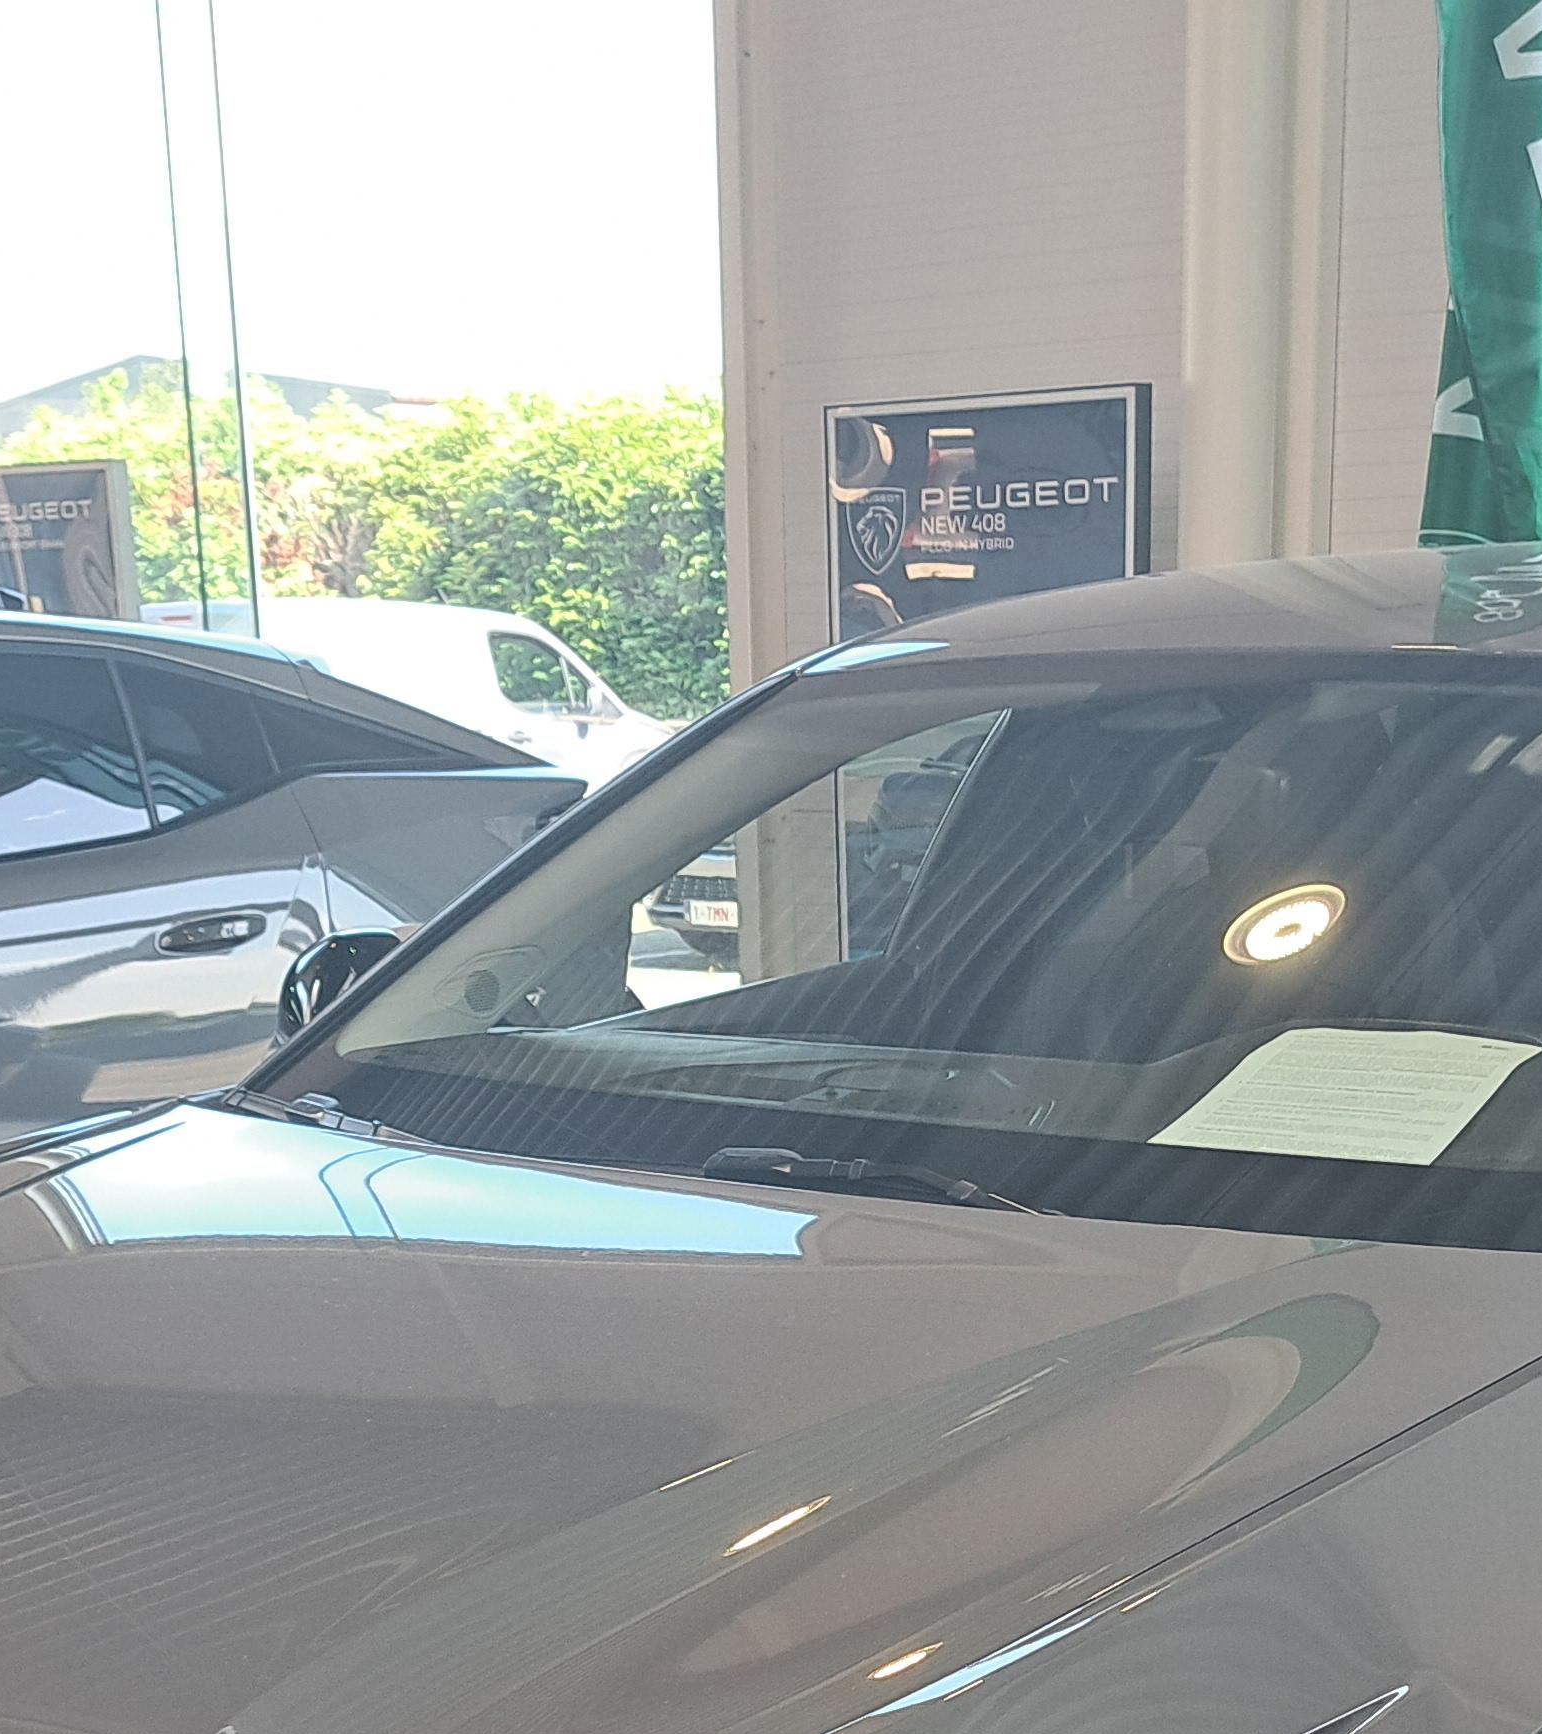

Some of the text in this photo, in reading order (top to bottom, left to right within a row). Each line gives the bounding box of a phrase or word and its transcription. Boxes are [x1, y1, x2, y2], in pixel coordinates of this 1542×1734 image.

[920, 475, 1119, 513] PEUGEOT
[920, 513, 1006, 535] NEW 408
